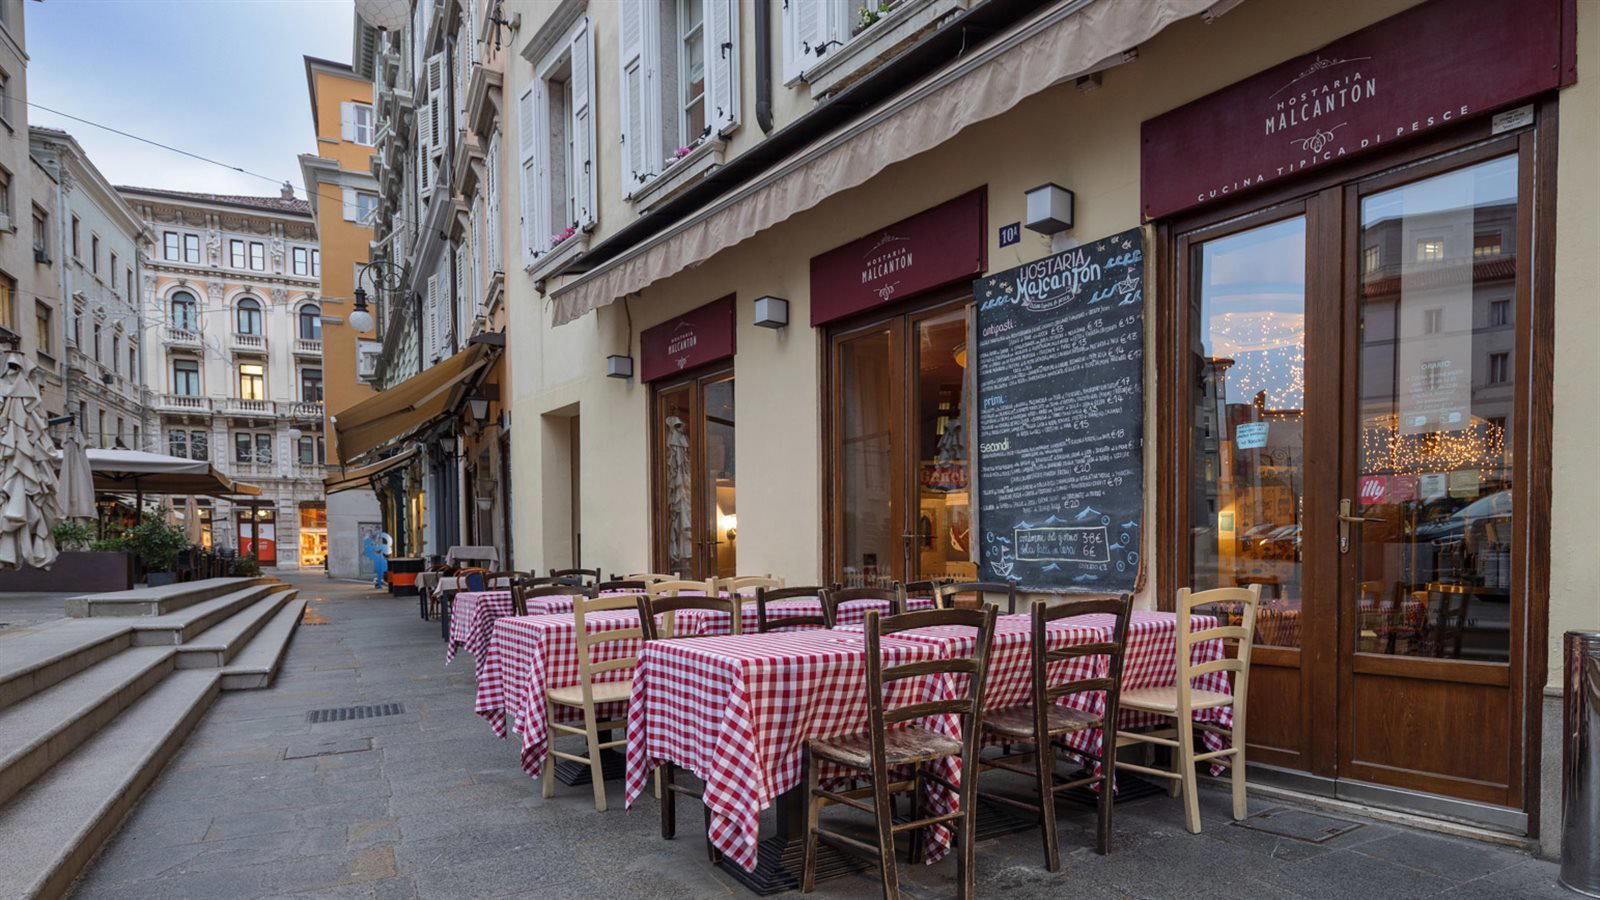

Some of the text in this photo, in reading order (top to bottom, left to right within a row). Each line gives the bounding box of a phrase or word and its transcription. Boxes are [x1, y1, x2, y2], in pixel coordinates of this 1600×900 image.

[1265, 78, 1376, 136] MALCANTON
[1277, 72, 1361, 111] HOSTARIA
[1198, 174, 1264, 202] CUCINA
[1277, 147, 1346, 176] TIPICA
[1360, 134, 1380, 148] DI
[1397, 105, 1469, 136] PESCE
[862, 252, 913, 284] MALCANTON
[866, 248, 906, 267] HOSTARIA
[1020, 248, 1085, 282] HOSTARIA
[668, 336, 697, 355] MALCANTON
[1361, 480, 1385, 500] illy
